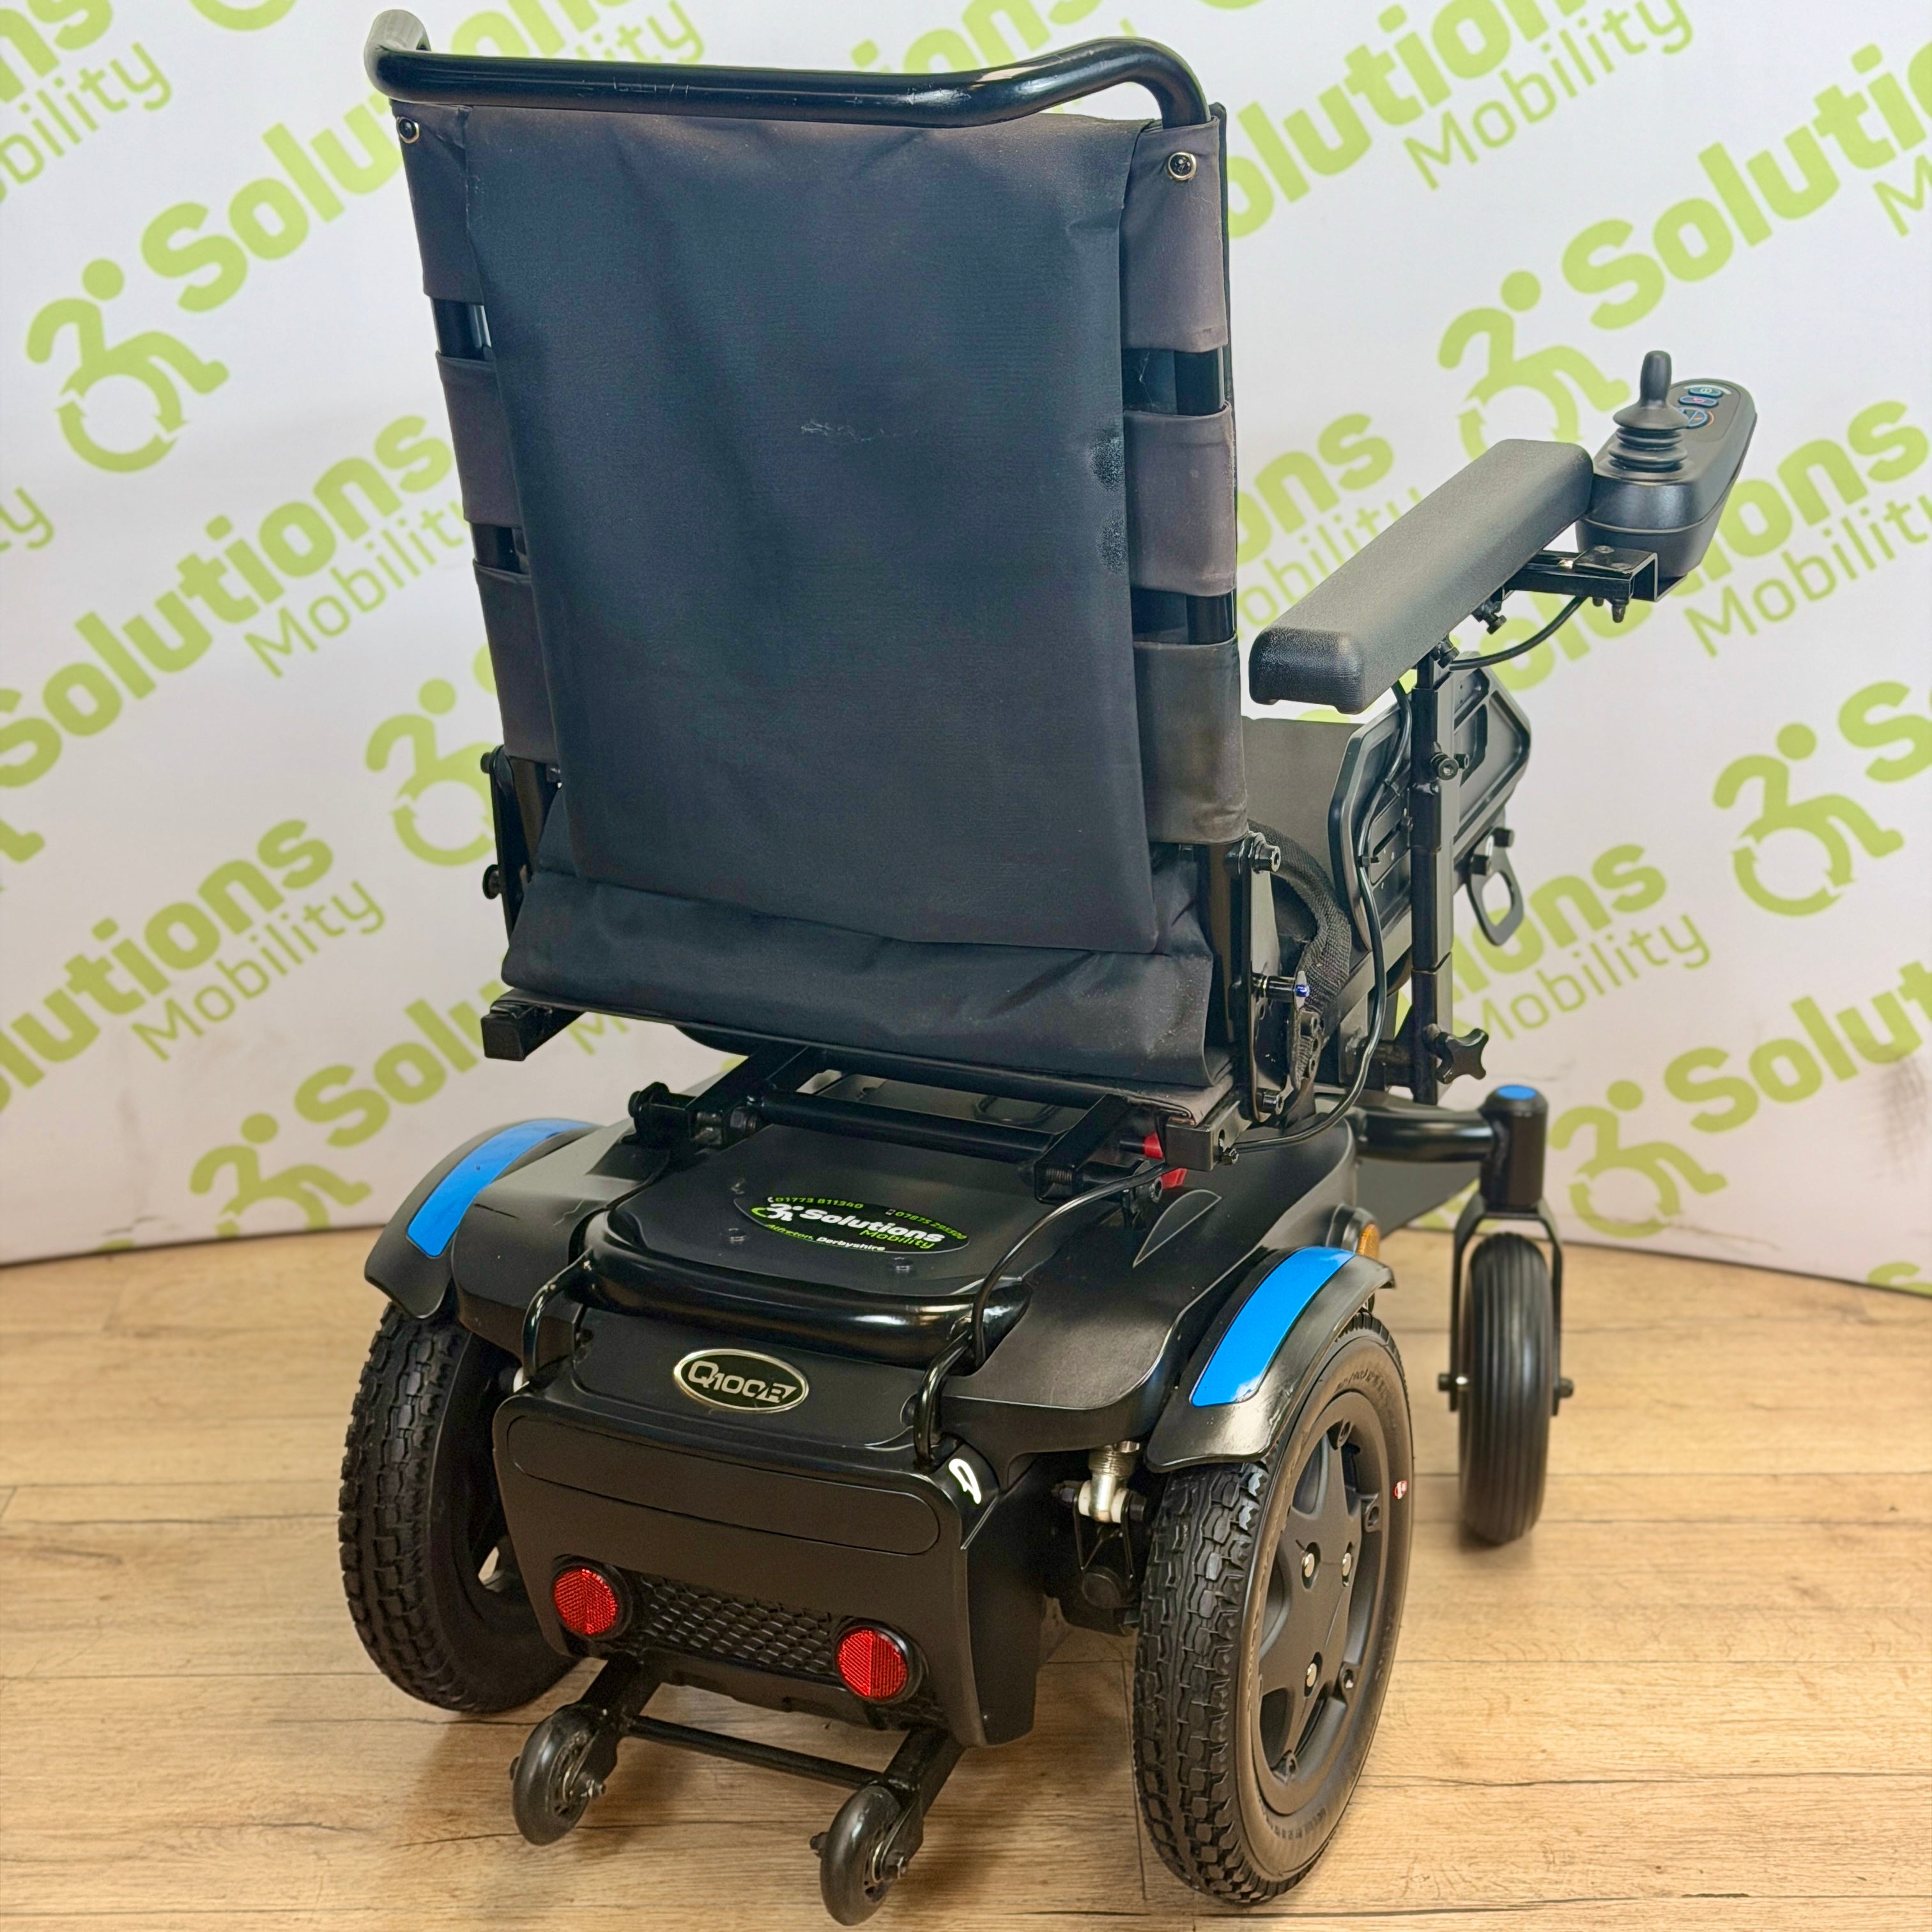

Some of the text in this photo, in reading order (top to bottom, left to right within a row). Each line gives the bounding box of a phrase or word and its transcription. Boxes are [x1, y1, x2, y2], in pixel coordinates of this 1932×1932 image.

[1403, 0, 1694, 190] Mobility
[129, 881, 386, 1064] Mobility
[799, 1208, 946, 1243] Solutions
[859, 1229, 935, 1250] Mobility
[815, 1236, 886, 1252] Derbyshire
